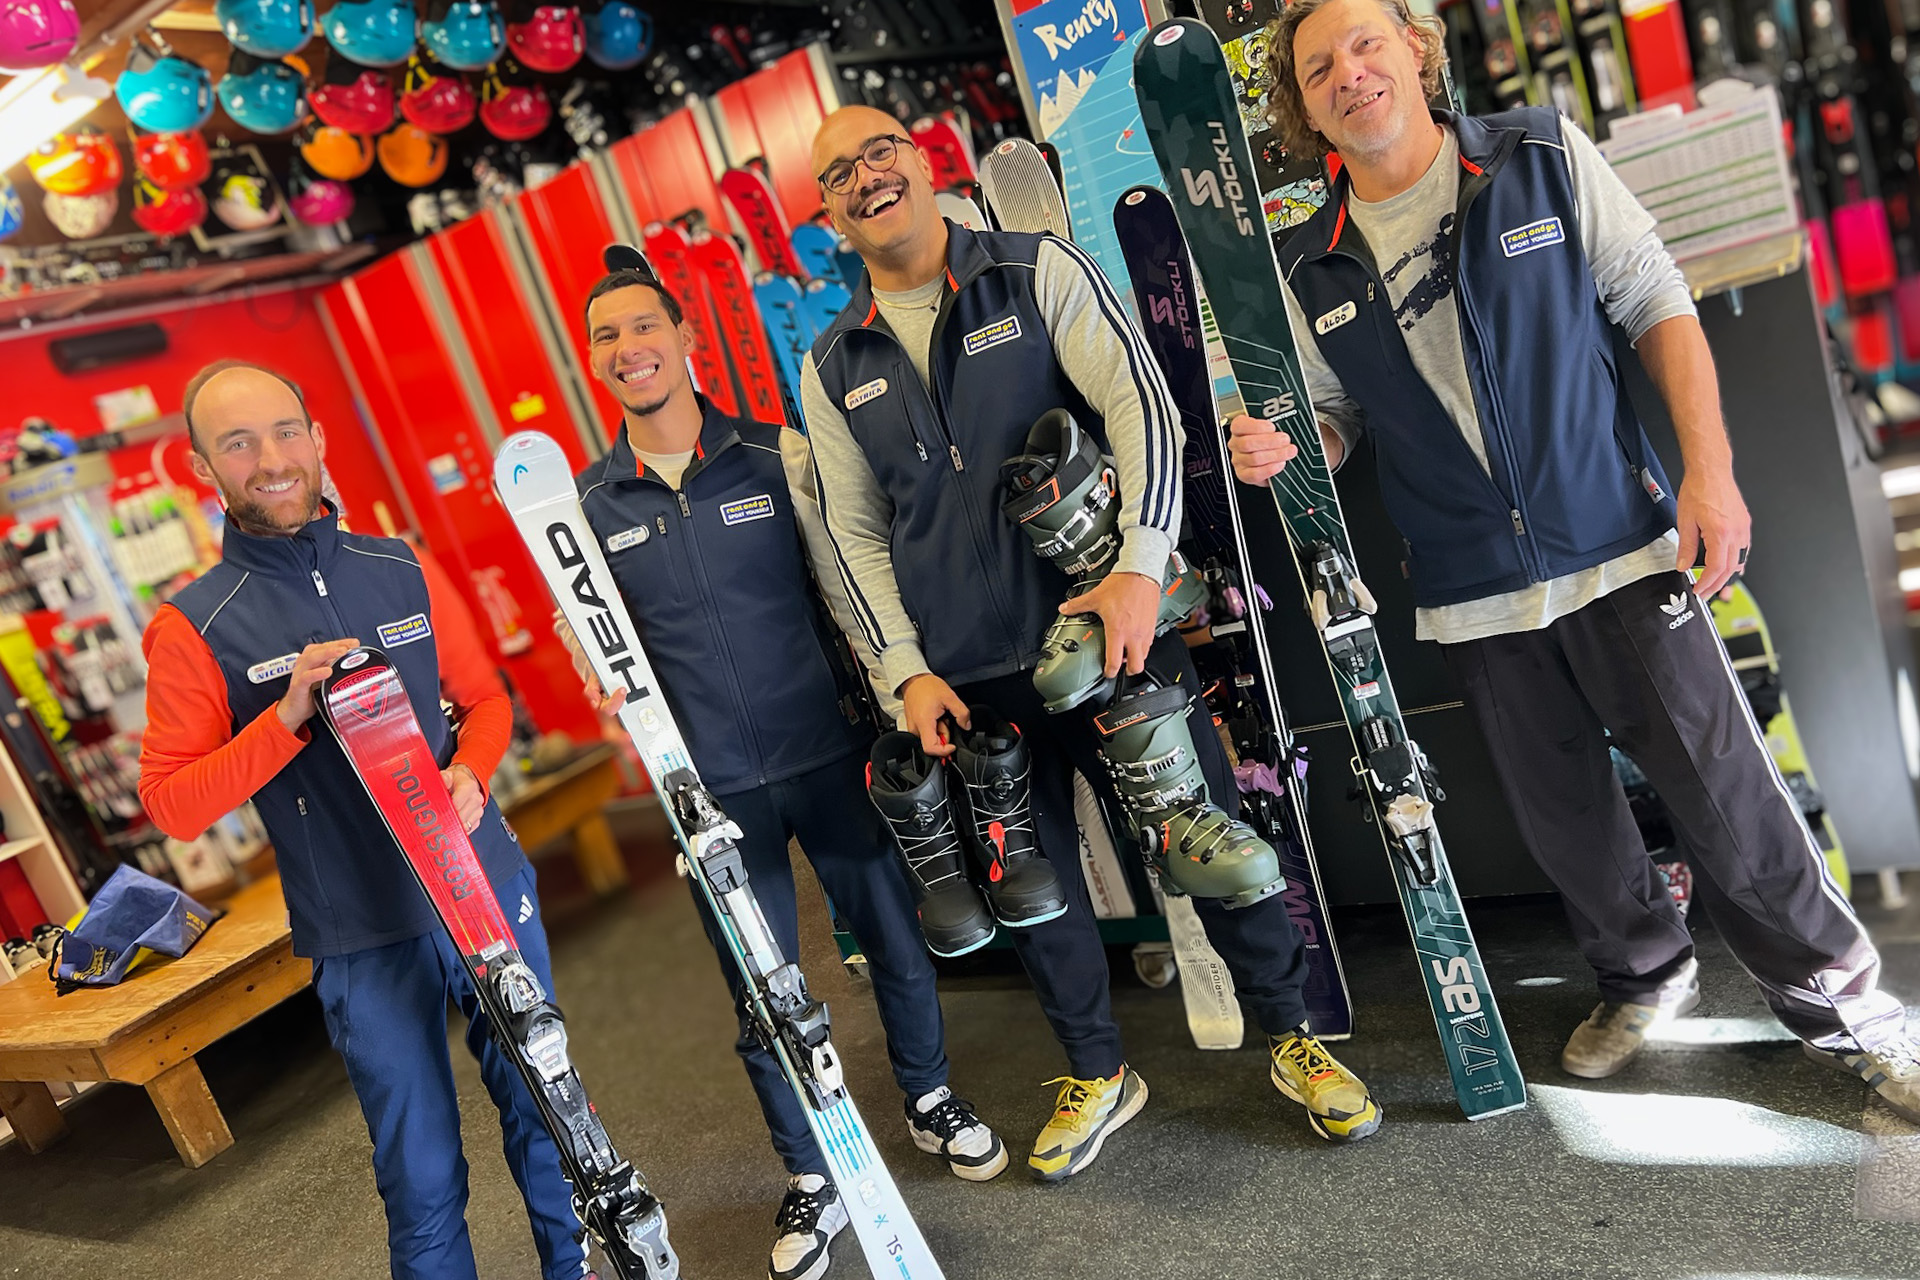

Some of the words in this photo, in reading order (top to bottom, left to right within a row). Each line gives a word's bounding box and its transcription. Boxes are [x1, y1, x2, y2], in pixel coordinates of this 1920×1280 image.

[1033, 0, 1118, 61] Renty
[1207, 121, 1255, 236] STÖCKLI
[1507, 231, 1528, 243] rent
[1528, 224, 1546, 235] and
[1545, 223, 1556, 232] go
[1509, 239, 1530, 250] SPORT
[1167, 260, 1195, 350] STÖCKLI
[1323, 313, 1347, 330] ALDO
[969, 331, 987, 343] rent
[986, 325, 1002, 336] and
[1002, 322, 1013, 331] go
[970, 338, 988, 350] SPORT
[849, 387, 882, 407] PATRICK
[726, 505, 743, 514] rent
[743, 500, 757, 510] and
[758, 500, 768, 508] go
[618, 537, 636, 547] OMAR
[546, 522, 650, 704] HEAD
[1668, 610, 1695, 630] adidas
[383, 626, 398, 636] rent
[398, 621, 413, 632] and
[413, 619, 423, 628] go
[1114, 711, 1146, 727] TECNICA
[391, 757, 476, 902] ROSSIGNOL
[1432, 956, 1481, 1013] as
[1450, 1011, 1484, 1025] MONTERO
[1452, 1017, 1499, 1077] 172
[886, 1234, 903, 1256] SL
